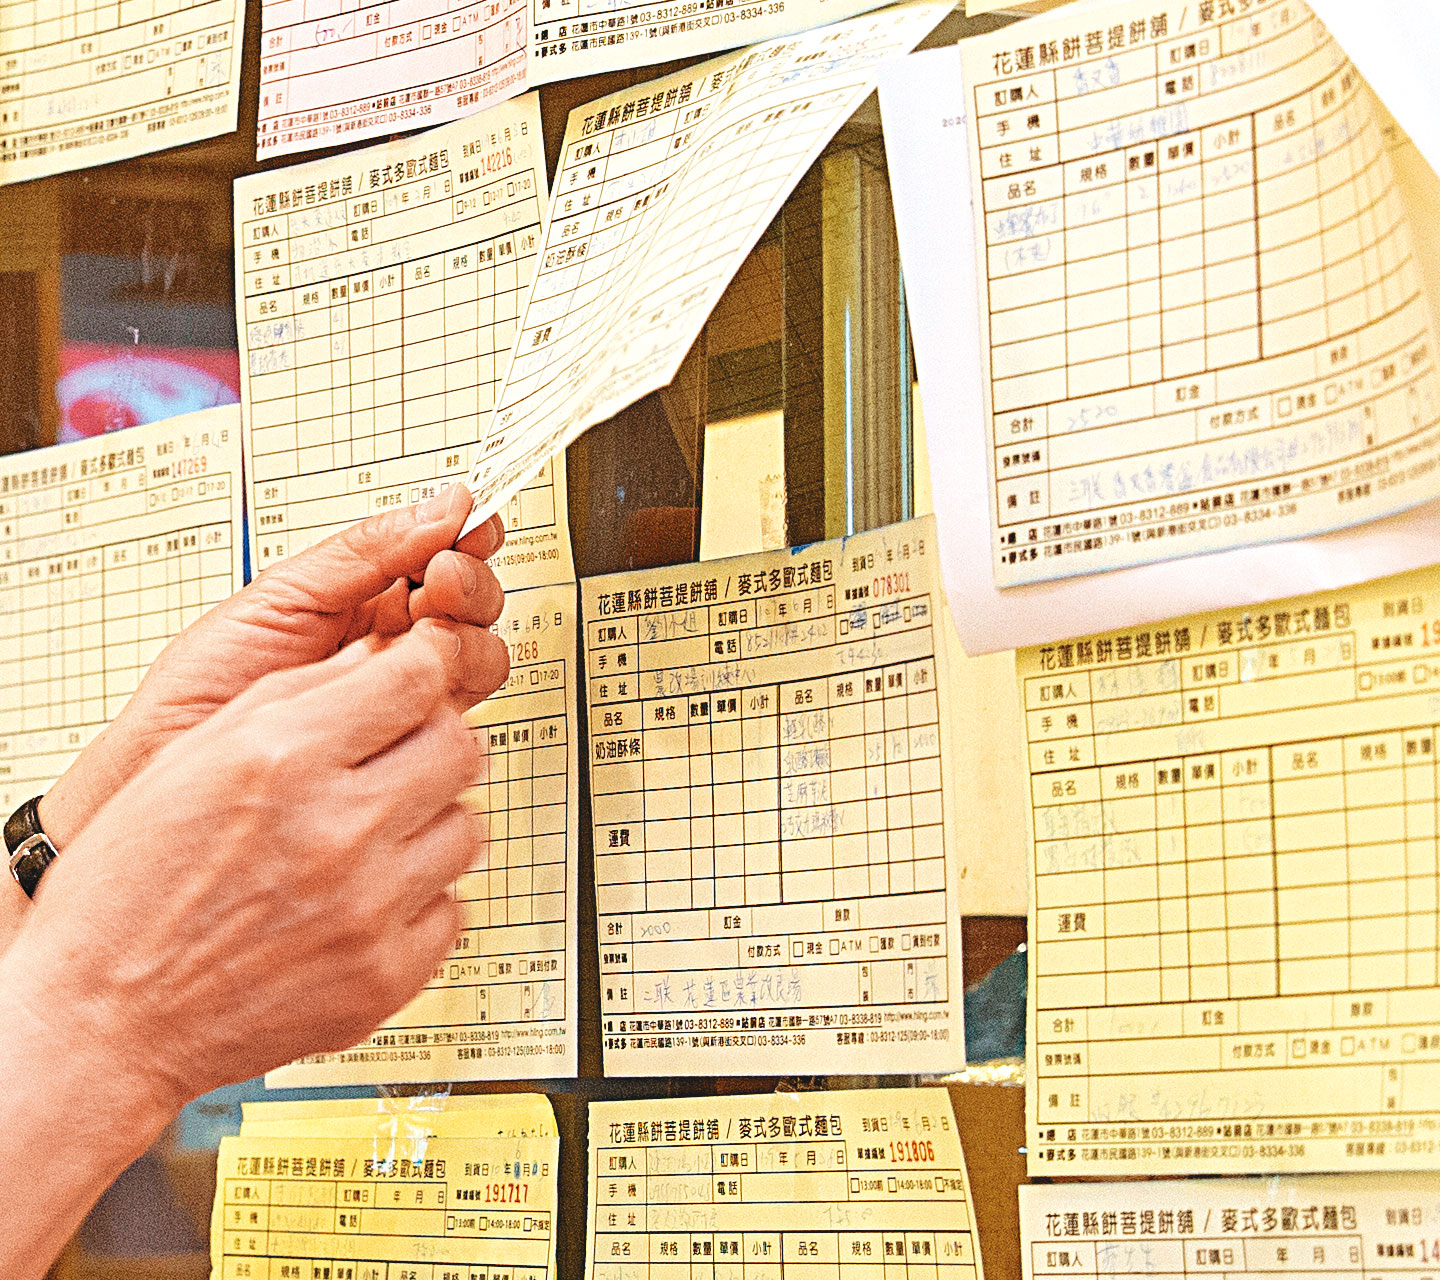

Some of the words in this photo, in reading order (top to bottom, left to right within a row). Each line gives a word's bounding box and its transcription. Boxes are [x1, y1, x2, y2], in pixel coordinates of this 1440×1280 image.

[992, 11, 1168, 74] 花蓮縣餅菩提餅舖
[481, 147, 513, 177] 142216
[252, 175, 354, 217] 花蓮縣餅菩提餅舖
[368, 148, 450, 189] 麥式多歐式麵包
[597, 579, 719, 615] 花蓮縣餅菩提餅舖
[737, 559, 833, 593] 麥式多歐式麵包
[873, 572, 911, 598] 078301
[1039, 630, 1191, 670] 花蓮縣餅菩提餅舖
[1217, 602, 1352, 647] 麥式多歐式麵包
[540, 669, 559, 681] 17-20
[595, 738, 641, 759] 奶油酥條
[609, 1119, 719, 1143] 花蓮縣餅菩提餅舖
[738, 1113, 842, 1139] 麥式多歐式麵包
[862, 1117, 888, 1132] 到貨日
[609, 1156, 637, 1170] 訂購人
[721, 1153, 748, 1167] 訂購日
[890, 1140, 934, 1162] 191806
[485, 1184, 528, 1203] 191717
[1045, 1209, 1194, 1238] 花蓮縣餅菩提餅舖
[1221, 1206, 1358, 1233] 麥式多歐式麵包
[661, 1241, 678, 1256] 規格
[693, 1241, 712, 1256] 數量
[719, 1240, 741, 1256] 單價
[751, 1241, 772, 1256] 小計
[851, 1241, 872, 1256] 規格
[885, 1241, 905, 1257] 數量
[911, 1241, 933, 1257] 單價
[943, 1241, 964, 1257] 小計
